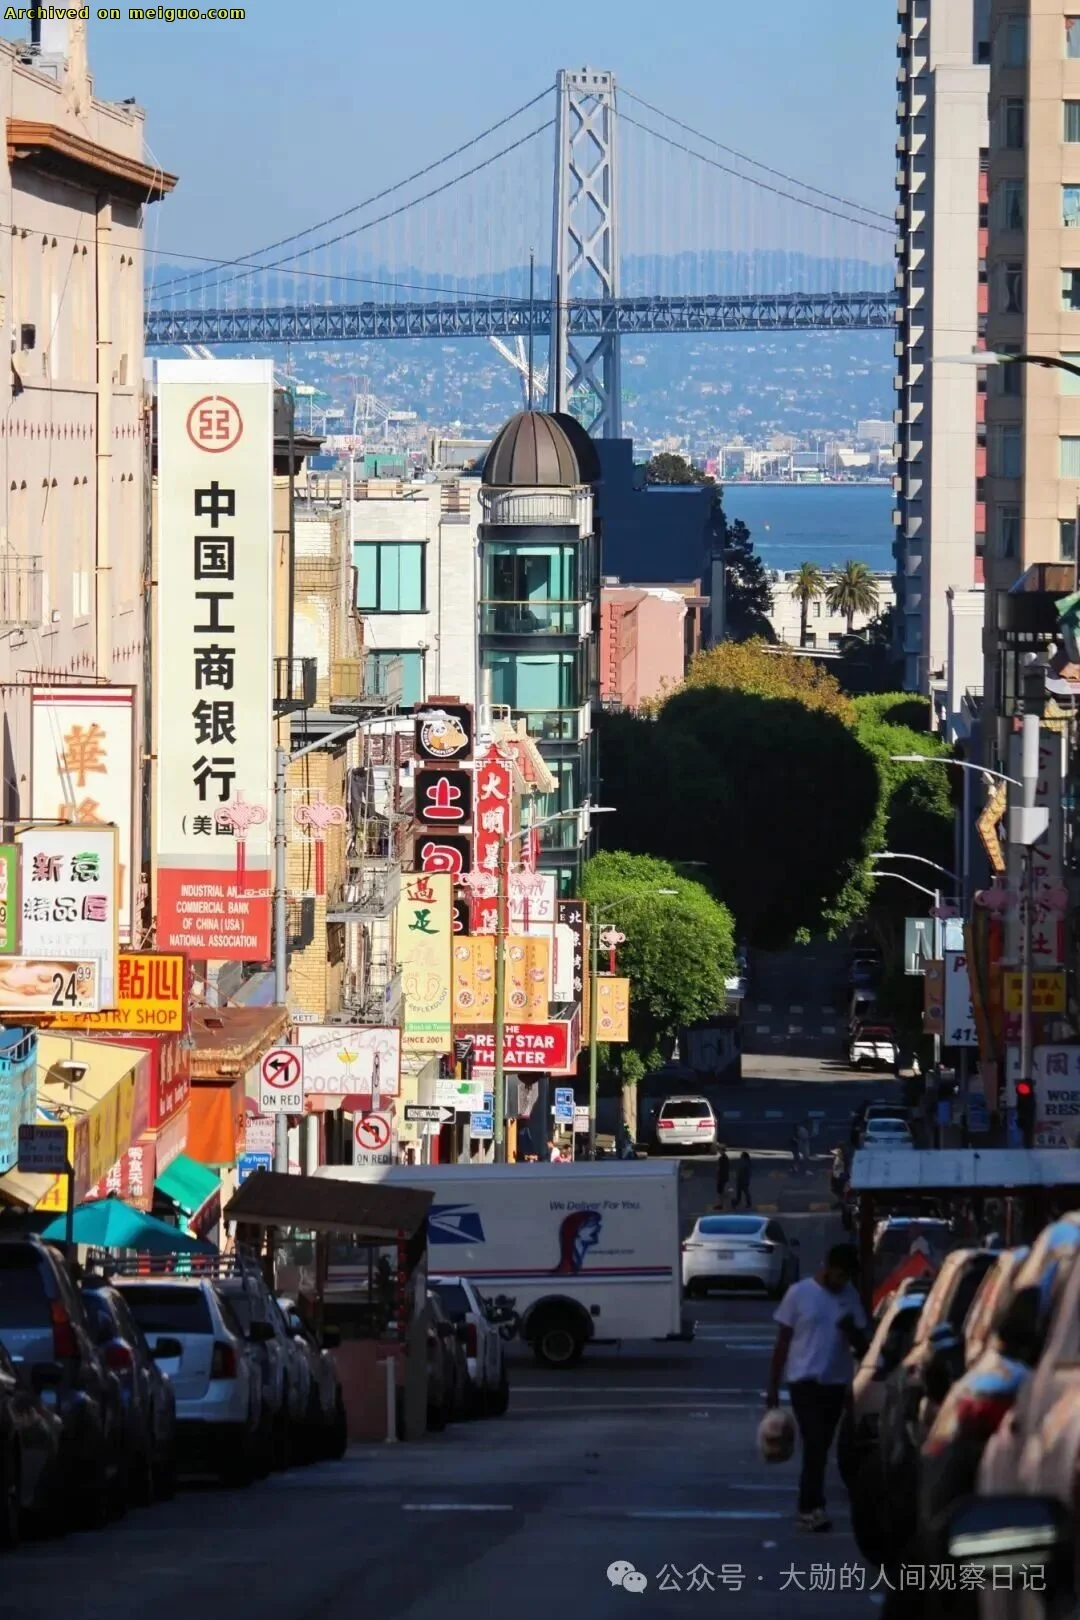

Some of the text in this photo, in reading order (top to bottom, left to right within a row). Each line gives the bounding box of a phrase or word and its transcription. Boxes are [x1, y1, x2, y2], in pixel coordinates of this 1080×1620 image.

[192, 480, 237, 802] 中国工商银行
[181, 884, 239, 896] INDUSTRIAL AN
[176, 901, 249, 914] COMMERCIAL BANK
[182, 918, 193, 930] OF
[169, 935, 257, 948] NATIONAL ASSOCIATION
[118, 959, 179, 1000] 點心
[136, 1009, 178, 1024] SHOP
[505, 1025, 520, 1034] HE
[402, 1036, 443, 1044] SINCE 2001
[515, 1035, 555, 1048] STAR
[473, 1050, 546, 1064] THATER
[304, 1075, 395, 1093] COCKTAS
[262, 1095, 300, 1105] ON RED
[409, 1109, 440, 1118] ONE WAY
[356, 1153, 388, 1162] ON RED
[549, 1201, 564, 1210] We
[566, 1200, 600, 1210] Deliver
[603, 1200, 619, 1210] For
